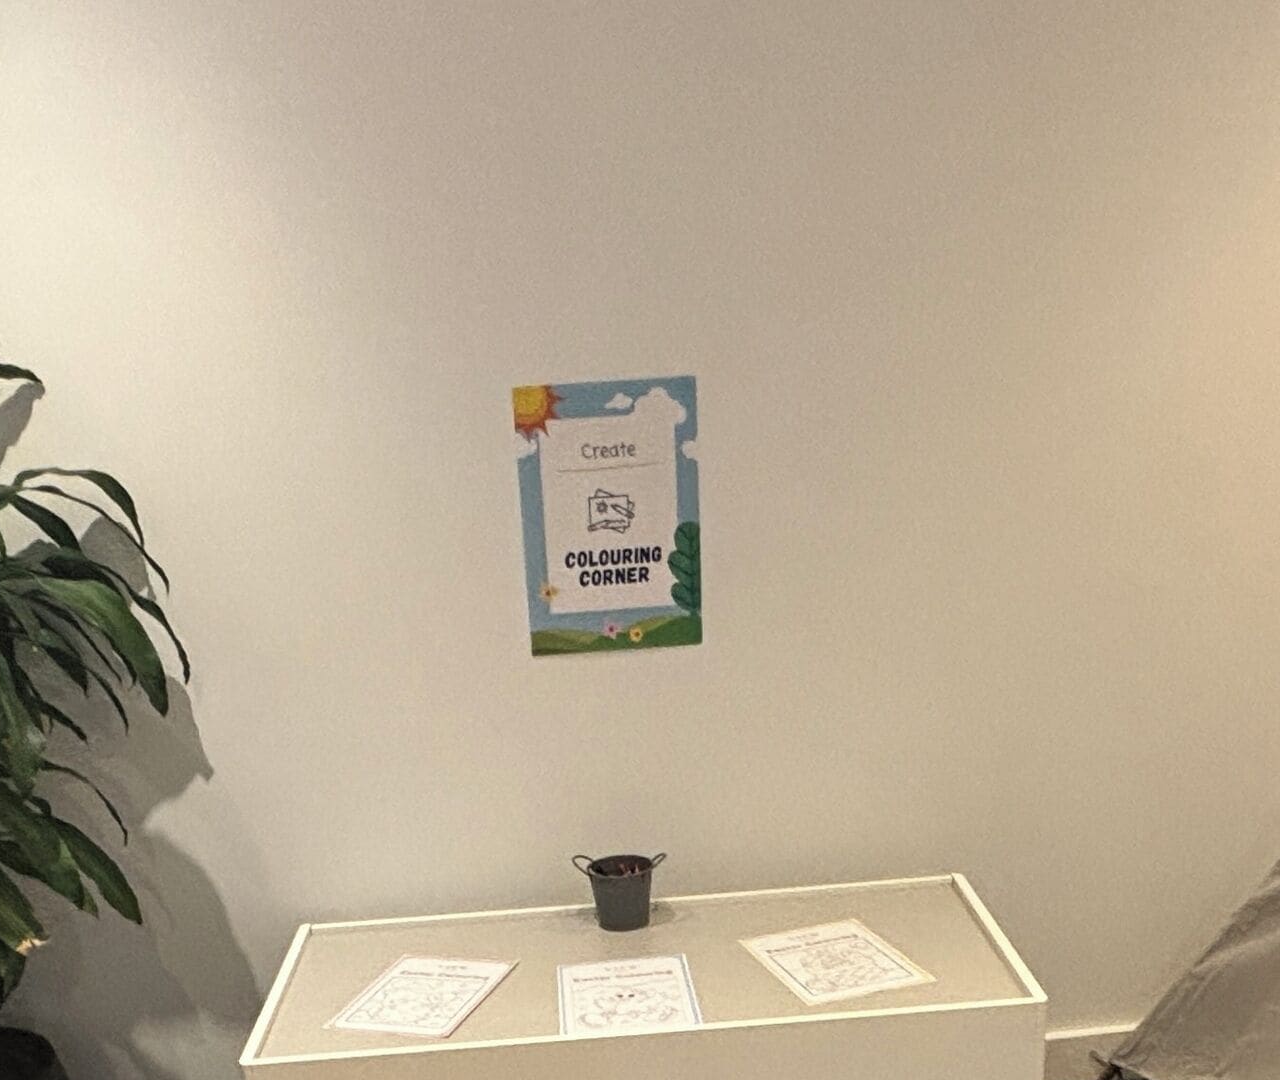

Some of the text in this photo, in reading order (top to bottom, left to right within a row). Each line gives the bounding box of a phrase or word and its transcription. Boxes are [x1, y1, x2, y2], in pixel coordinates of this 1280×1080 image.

[582, 442, 636, 459] Create
[565, 546, 663, 569] COLOURING
[579, 567, 650, 587] CORNER
